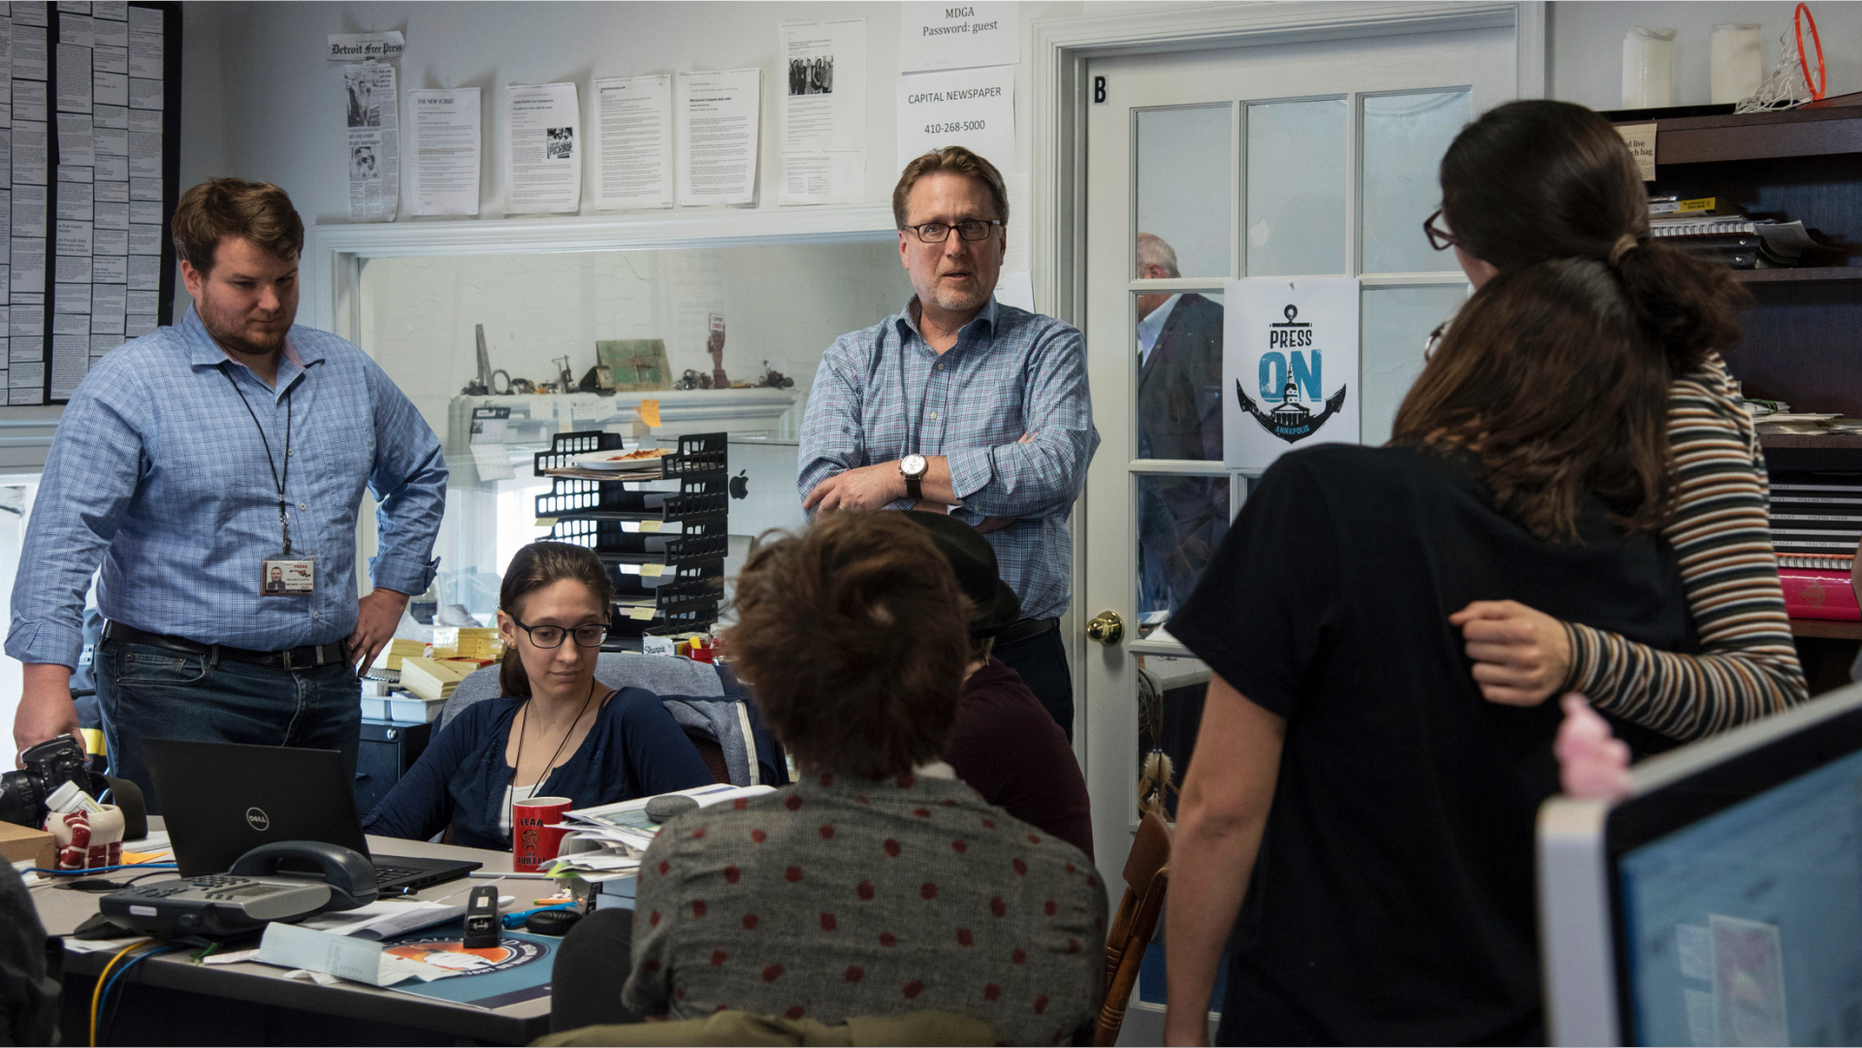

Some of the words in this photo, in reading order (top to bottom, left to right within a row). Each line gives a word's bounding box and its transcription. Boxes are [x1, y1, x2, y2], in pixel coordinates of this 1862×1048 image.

[945, 7, 975, 19] MDGA
[922, 22, 971, 36] Password:
[972, 20, 998, 34] guest
[331, 43, 363, 55] Detroit
[364, 43, 382, 55] Free
[383, 42, 403, 55] Press
[908, 92, 944, 104] CAPITAL
[946, 87, 1002, 102] NEWSPAPER
[1094, 76, 1107, 103] B
[924, 119, 986, 134] 410-268-5000
[1640, 148, 1653, 157] bag
[1270, 329, 1312, 349] PRESS
[1258, 349, 1322, 403] ON
[1275, 424, 1310, 435] ANNAPOLIS
[644, 645, 667, 656] Sharpie
[249, 815, 267, 823] DELL
[520, 818, 544, 828] FEAR
